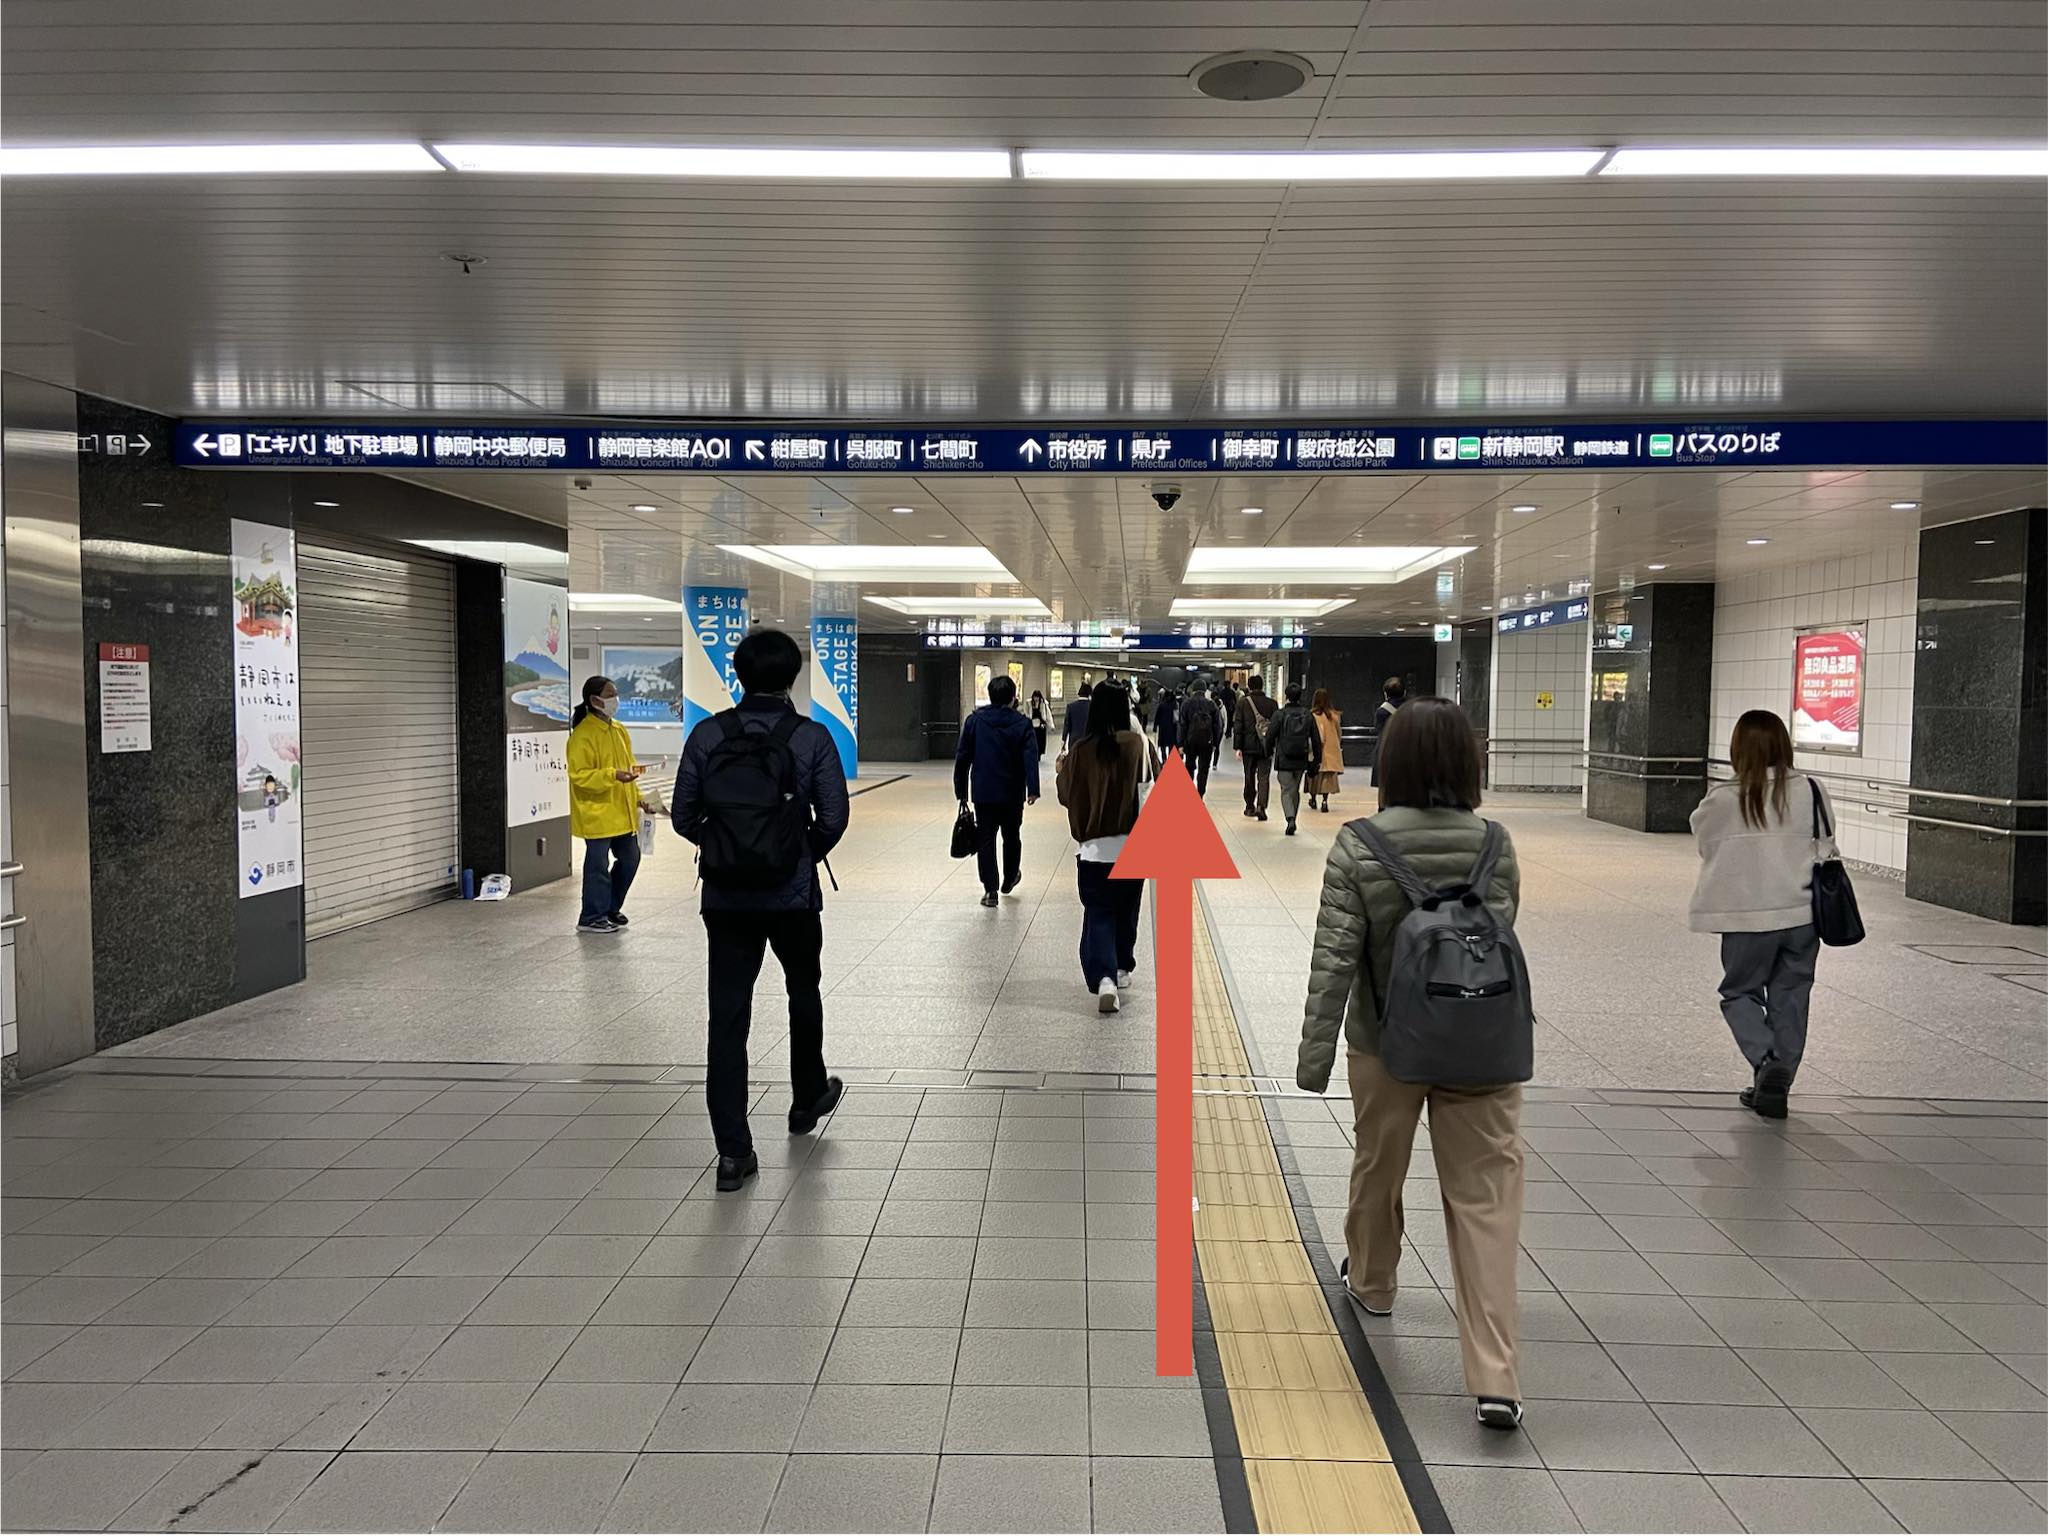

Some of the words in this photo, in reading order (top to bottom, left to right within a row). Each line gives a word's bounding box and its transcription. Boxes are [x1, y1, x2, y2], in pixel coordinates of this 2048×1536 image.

[325, 435, 417, 456] 地下駐車場
[434, 436, 566, 457] 静岡中央郵便局
[598, 437, 731, 459] 静岡音楽館AOI
[770, 439, 828, 460] 紺屋町
[846, 439, 903, 460] 呉服町
[920, 439, 978, 460] 七間町
[1048, 439, 1106, 460] 市役所
[1131, 439, 1172, 460] 県庁
[1223, 438, 1280, 459] 御幸町
[1296, 438, 1395, 459] 駿府城公園
[1482, 436, 1564, 458] 新静岡駅
[1573, 440, 1629, 456] 静岡鉄道
[1676, 432, 1781, 454] バスのりば
[248, 456, 302, 465] Underground
[303, 456, 332, 465] Parking
[435, 457, 474, 466] Shizuoka
[476, 457, 499, 466] Chuo
[501, 457, 520, 466] Post
[522, 457, 548, 466] Office
[600, 458, 638, 467] Shizuoka
[640, 458, 675, 467] Concert
[676, 458, 693, 467] Hall
[773, 459, 824, 469] Koya-machi
[847, 459, 897, 469] Gofuku-cho
[923, 459, 984, 469] Shichiken-cho
[1048, 459, 1068, 471] City
[1071, 459, 1090, 469] Hall
[1131, 459, 1176, 469] Prefectural
[1178, 459, 1208, 469] Offices
[1223, 458, 1274, 470] Miyuki-cho
[1296, 458, 1331, 470] Sumpu
[1332, 458, 1363, 468] Castle
[1365, 457, 1387, 468] Park
[1481, 455, 1548, 466] Shin-Shizuoka
[1550, 455, 1584, 465] Station
[1676, 453, 1693, 463] Bus
[1695, 453, 1715, 463] Stop
[698, 614, 719, 646] ON
[816, 637, 830, 660] ON
[833, 637, 848, 694] STAGE
